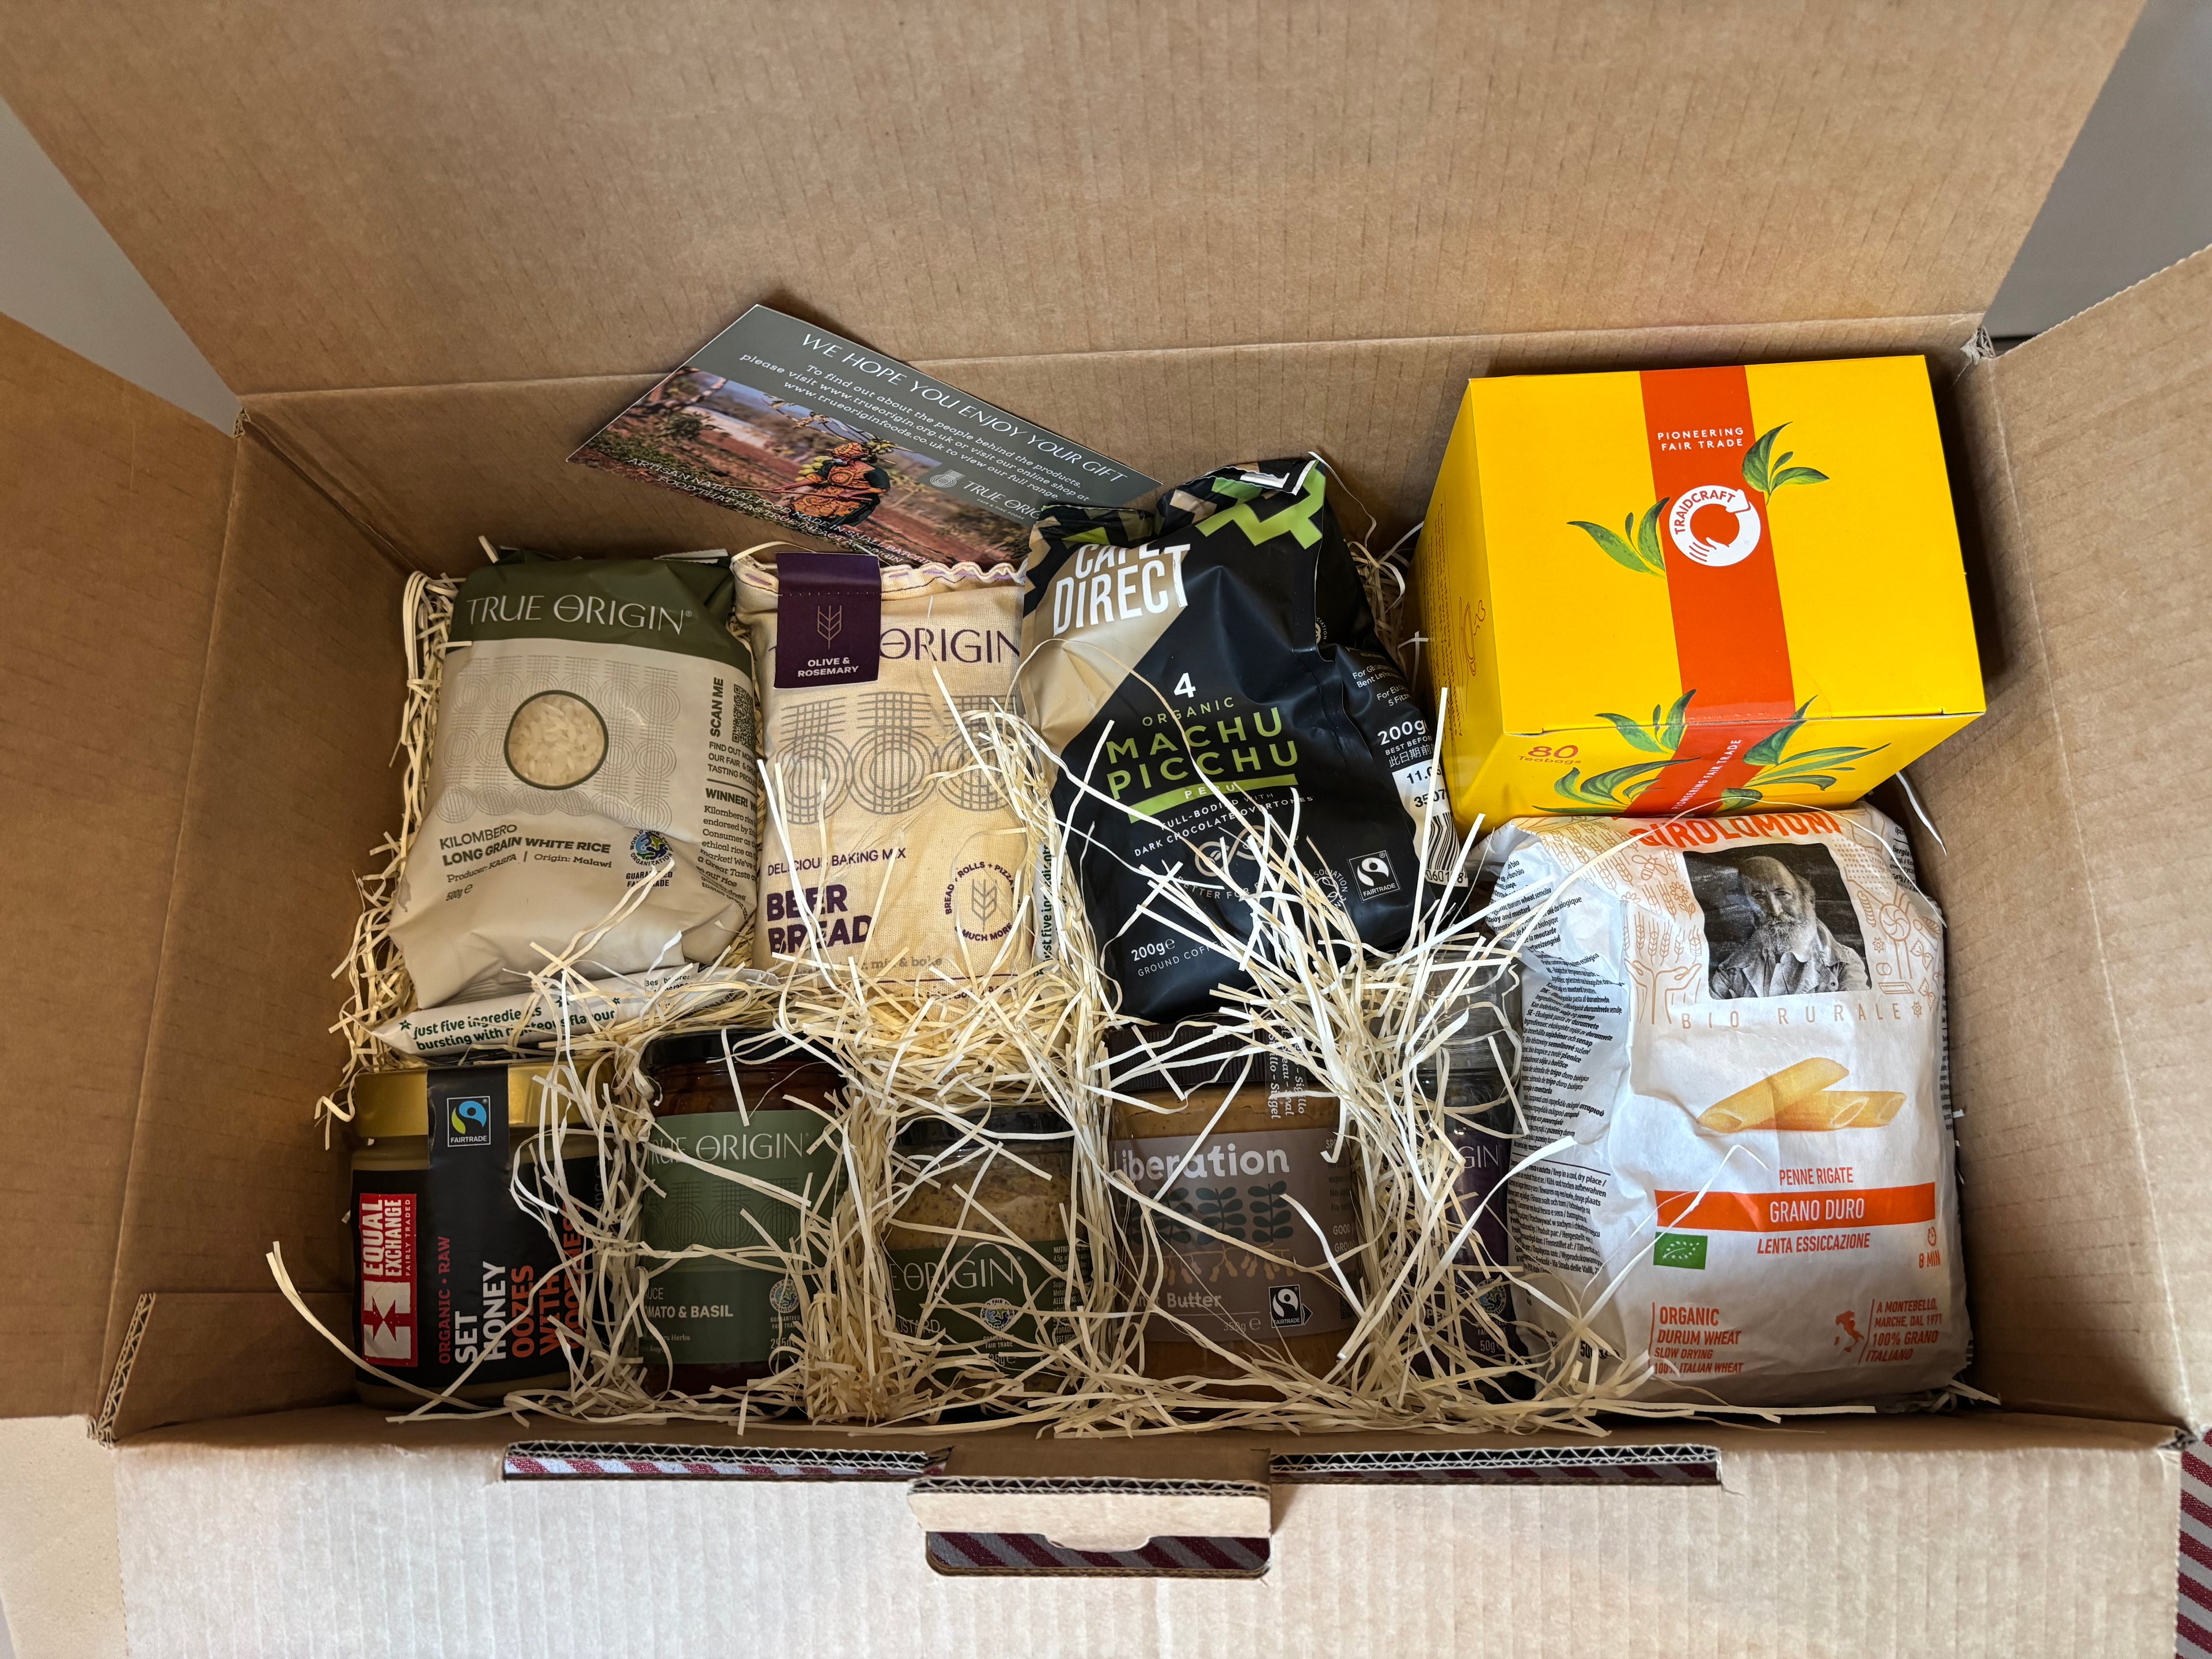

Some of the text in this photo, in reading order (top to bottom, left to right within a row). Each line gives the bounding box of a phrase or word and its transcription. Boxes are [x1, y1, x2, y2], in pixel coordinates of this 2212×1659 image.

[802, 334, 1128, 482] WE HOPE YOU ENJOY YOUR GIFT
[806, 365, 1033, 467] To find out about the people behind the
[740, 354, 1089, 501] please visit www.trueorigin.org.uk or visit our online shop at
[784, 382, 1026, 486] www.trueoriginfoods.co.uk to view our full
[1657, 427, 1744, 440] PIONEERING
[1661, 438, 1743, 451] FAIR TRADE
[963, 480, 1006, 503] TRUE
[628, 458, 885, 549] ARTISAN NATURAL FOOD MADE IN SMALL
[657, 476, 846, 543] FOOD THAT HAS TRUE IMPACT
[1674, 490, 1736, 535] TRAIDCRAFT
[1054, 544, 1191, 637] DIRECT
[467, 594, 546, 626] TRUE
[797, 665, 859, 677] ROSEMARY
[807, 657, 841, 667] OLIVE
[1173, 672, 1196, 698] 4
[1353, 669, 1366, 680] For
[1357, 676, 1376, 688] Bent
[1376, 690, 1390, 701] For
[710, 677, 724, 737] SCAN ME
[1142, 697, 1234, 727] ORGANIC
[1106, 707, 1282, 764] MACHU
[709, 741, 741, 756] FIND OUT
[1385, 744, 1404, 756] BEST
[1388, 743, 1435, 768] 此日期前
[1528, 745, 1578, 759] 80
[1716, 740, 1741, 764] TRADE
[708, 753, 740, 767] OUR FAIR
[1107, 740, 1298, 801] PICCHU
[1518, 755, 1582, 765] Teabags
[707, 764, 738, 778] TASTING
[705, 787, 748, 808] WINNER!
[1184, 784, 1235, 800] PEU
[704, 805, 744, 821] Kilombero
[1161, 798, 1238, 830] FULL-BODID
[703, 817, 740, 831] endorsed
[1134, 797, 1313, 857] DARK CHOCOLATE OVRTONES
[1628, 811, 1843, 849] GIROLOMONI
[440, 824, 517, 850] KILOMBERO
[630, 830, 644, 850] WORLD
[702, 828, 744, 843] Consumer
[442, 836, 611, 866] LONG GRAIN WHITE RICE
[702, 840, 744, 855] ethical rice
[832, 850, 878, 866] BAKING
[882, 848, 906, 859] MX
[534, 854, 612, 868] Origin: Malawi
[705, 858, 751, 880] Great Taste
[957, 862, 1014, 886] ROLLS PIZZA
[945, 884, 955, 915] BREAD
[1363, 882, 1396, 897] FAIRTRADE
[767, 884, 847, 922] BEER
[768, 915, 875, 956] BREAD
[962, 929, 988, 941] MUCH
[1041, 914, 1052, 938] five
[1138, 956, 1180, 976] GROUND
[413, 1007, 541, 1040] just five ingredies
[1682, 1003, 1902, 1029] BIO RURALE
[416, 1010, 616, 1051] bursting with flaour
[1575, 1036, 1593, 1047] senap
[450, 1135, 487, 1144] FAIRTRADE
[696, 1132, 803, 1161] ORIGIN
[1586, 1176, 1602, 1187] place
[1779, 1166, 1853, 1185] PENNE RIGATE
[1585, 1196, 1601, 1206] plaats
[1770, 1198, 1865, 1223] GRANO DURO
[362, 1199, 384, 1276] EQUAL
[384, 1199, 403, 1277] EXCHANGE
[1756, 1232, 1870, 1255] LENTA ESSICCAZIONE
[1927, 1251, 1940, 1267] MIN
[438, 1236, 450, 1365] ORGANIC RAW
[1166, 1291, 1222, 1308] Butter
[483, 1261, 507, 1362] HONEY
[511, 1265, 534, 1358] OOZES
[539, 1274, 560, 1356] WITH
[691, 1305, 734, 1318] BASIL
[1273, 1317, 1300, 1325] FAIRTRADE
[1659, 1306, 1719, 1326] ORGANIC
[1910, 1313, 1942, 1326] DAL 1971
[454, 1310, 478, 1364] SET
[671, 1334, 691, 1342] Herbs
[1657, 1330, 1741, 1345] DURUM WHEAT
[1872, 1330, 1939, 1347] 100% GRANO
[1654, 1347, 1713, 1359] SLOW DRYING
[1865, 1348, 1914, 1363] ITALIANO
[1679, 1362, 1713, 1374] ITALIAN
[1714, 1361, 1744, 1373] WHEAT
